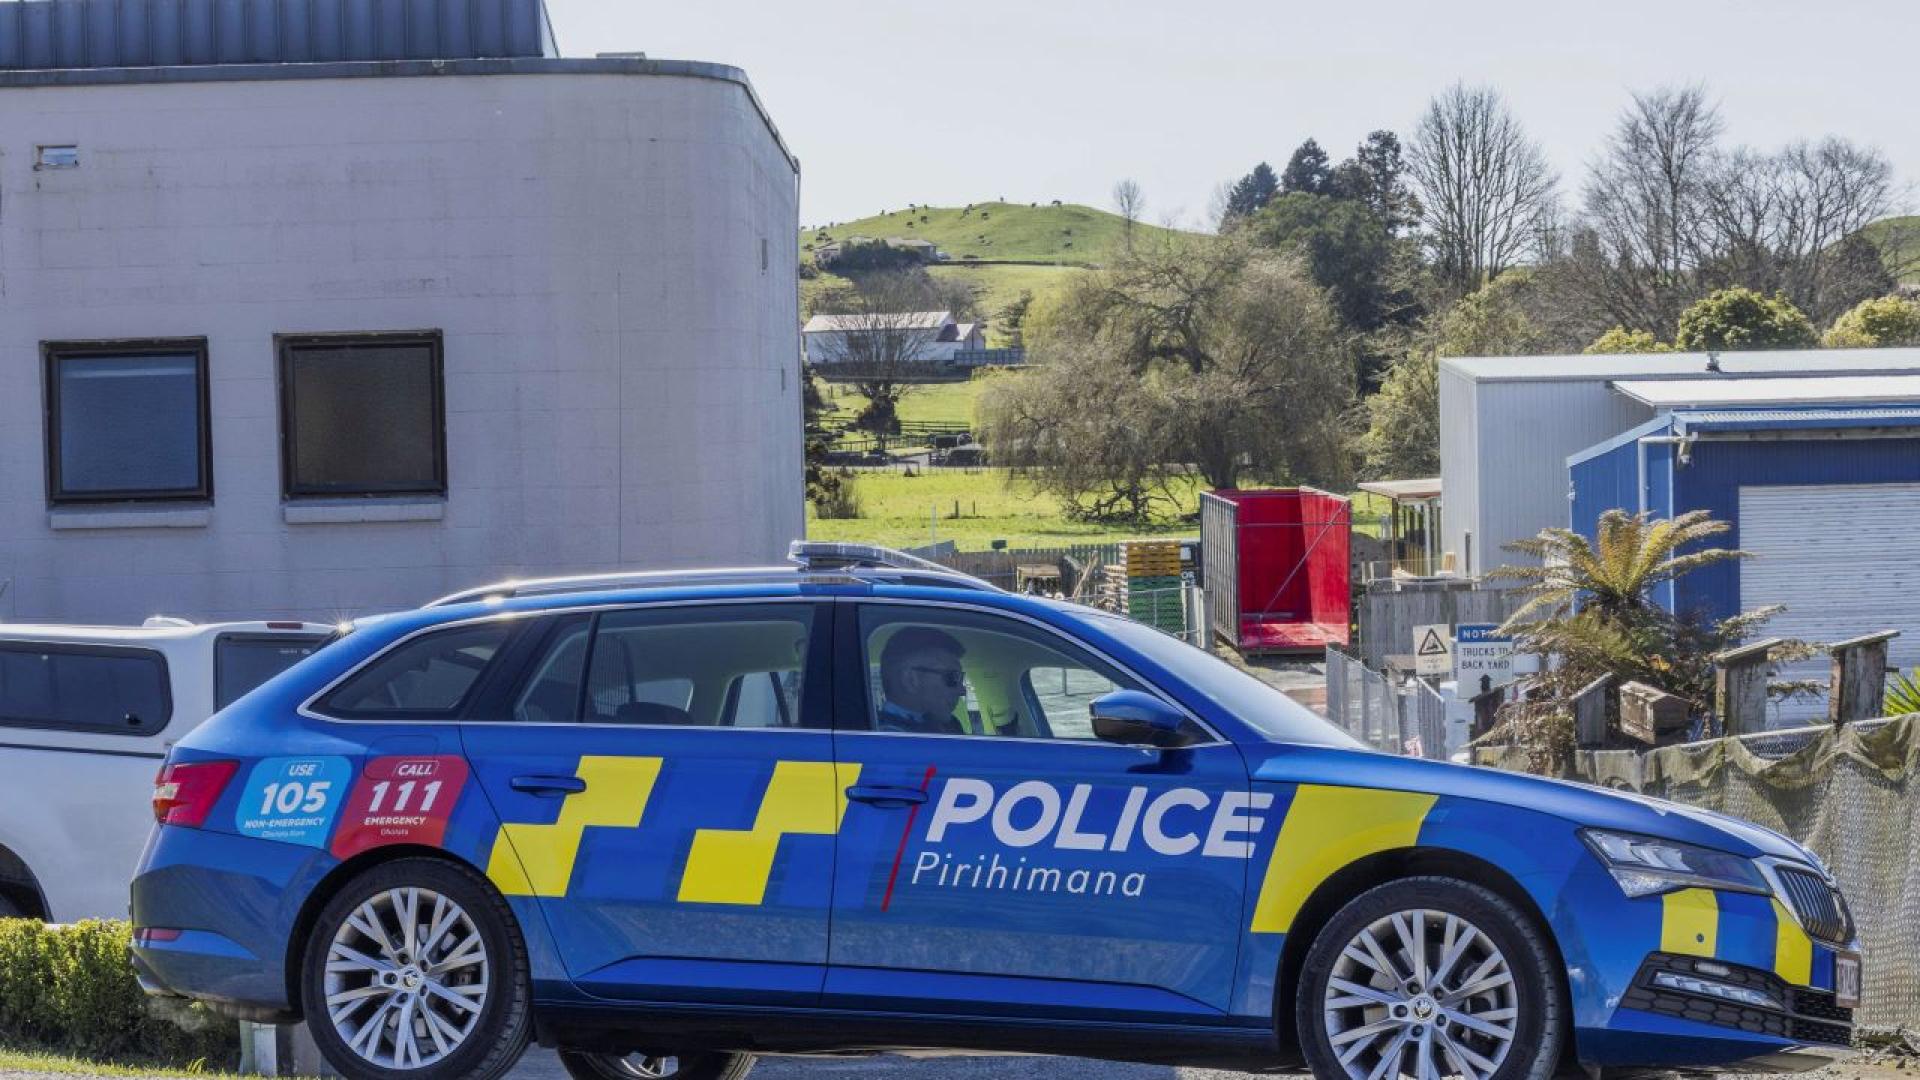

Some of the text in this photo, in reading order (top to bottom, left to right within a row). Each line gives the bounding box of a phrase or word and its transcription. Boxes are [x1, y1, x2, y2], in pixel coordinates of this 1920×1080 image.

[1462, 647, 1495, 656] TRUCKS
[1461, 660, 1510, 670] BACK YARD
[289, 764, 317, 776] USE
[398, 764, 433, 776] CALL
[260, 781, 332, 815] 105
[368, 780, 442, 812] 111
[244, 817, 325, 829] NON-EMERGENCY
[363, 816, 427, 826] EMERGENCY
[925, 777, 1274, 859] POLICE
[911, 851, 1147, 897] Pirihimana
